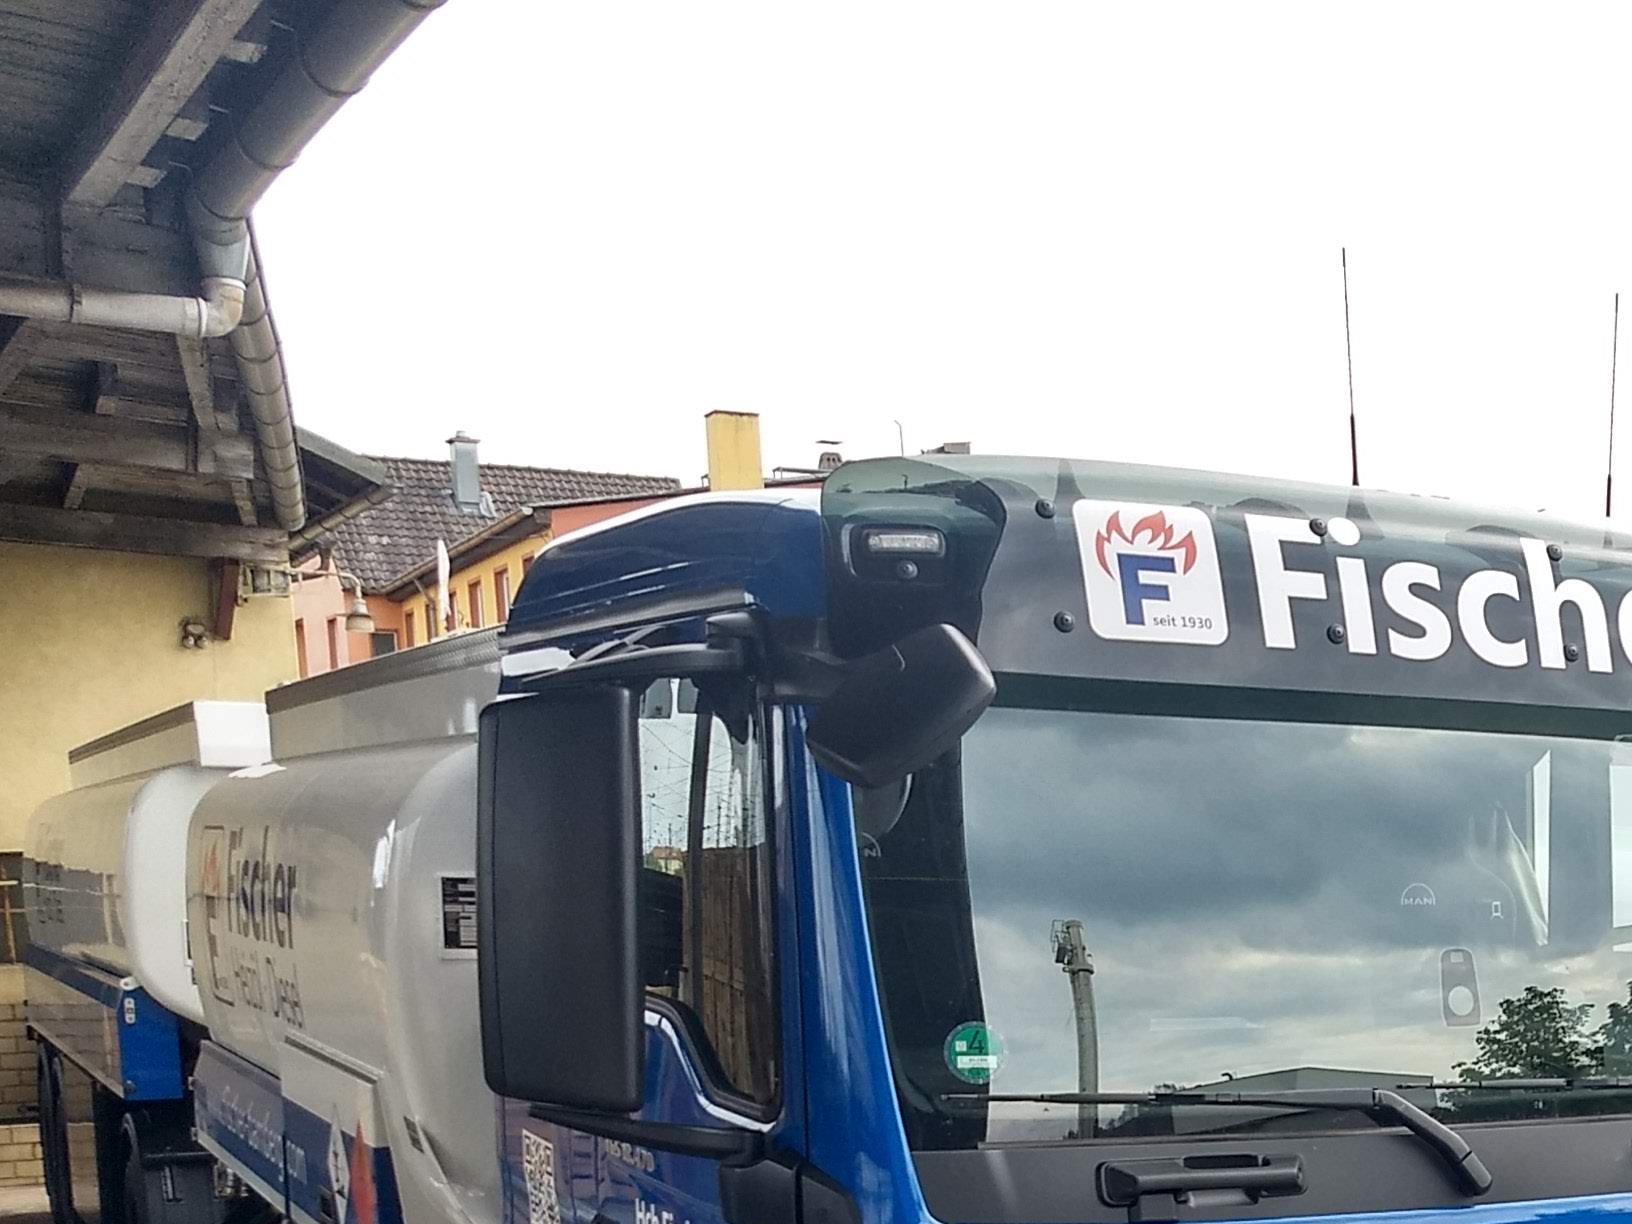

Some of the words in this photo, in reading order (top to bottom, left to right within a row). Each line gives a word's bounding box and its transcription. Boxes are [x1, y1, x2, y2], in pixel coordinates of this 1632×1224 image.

[1116, 552, 1177, 626] F
[1153, 614, 1177, 627] seit
[1181, 615, 1213, 630] 1930
[227, 824, 297, 950] Fischer
[967, 1030, 985, 1054] 4
